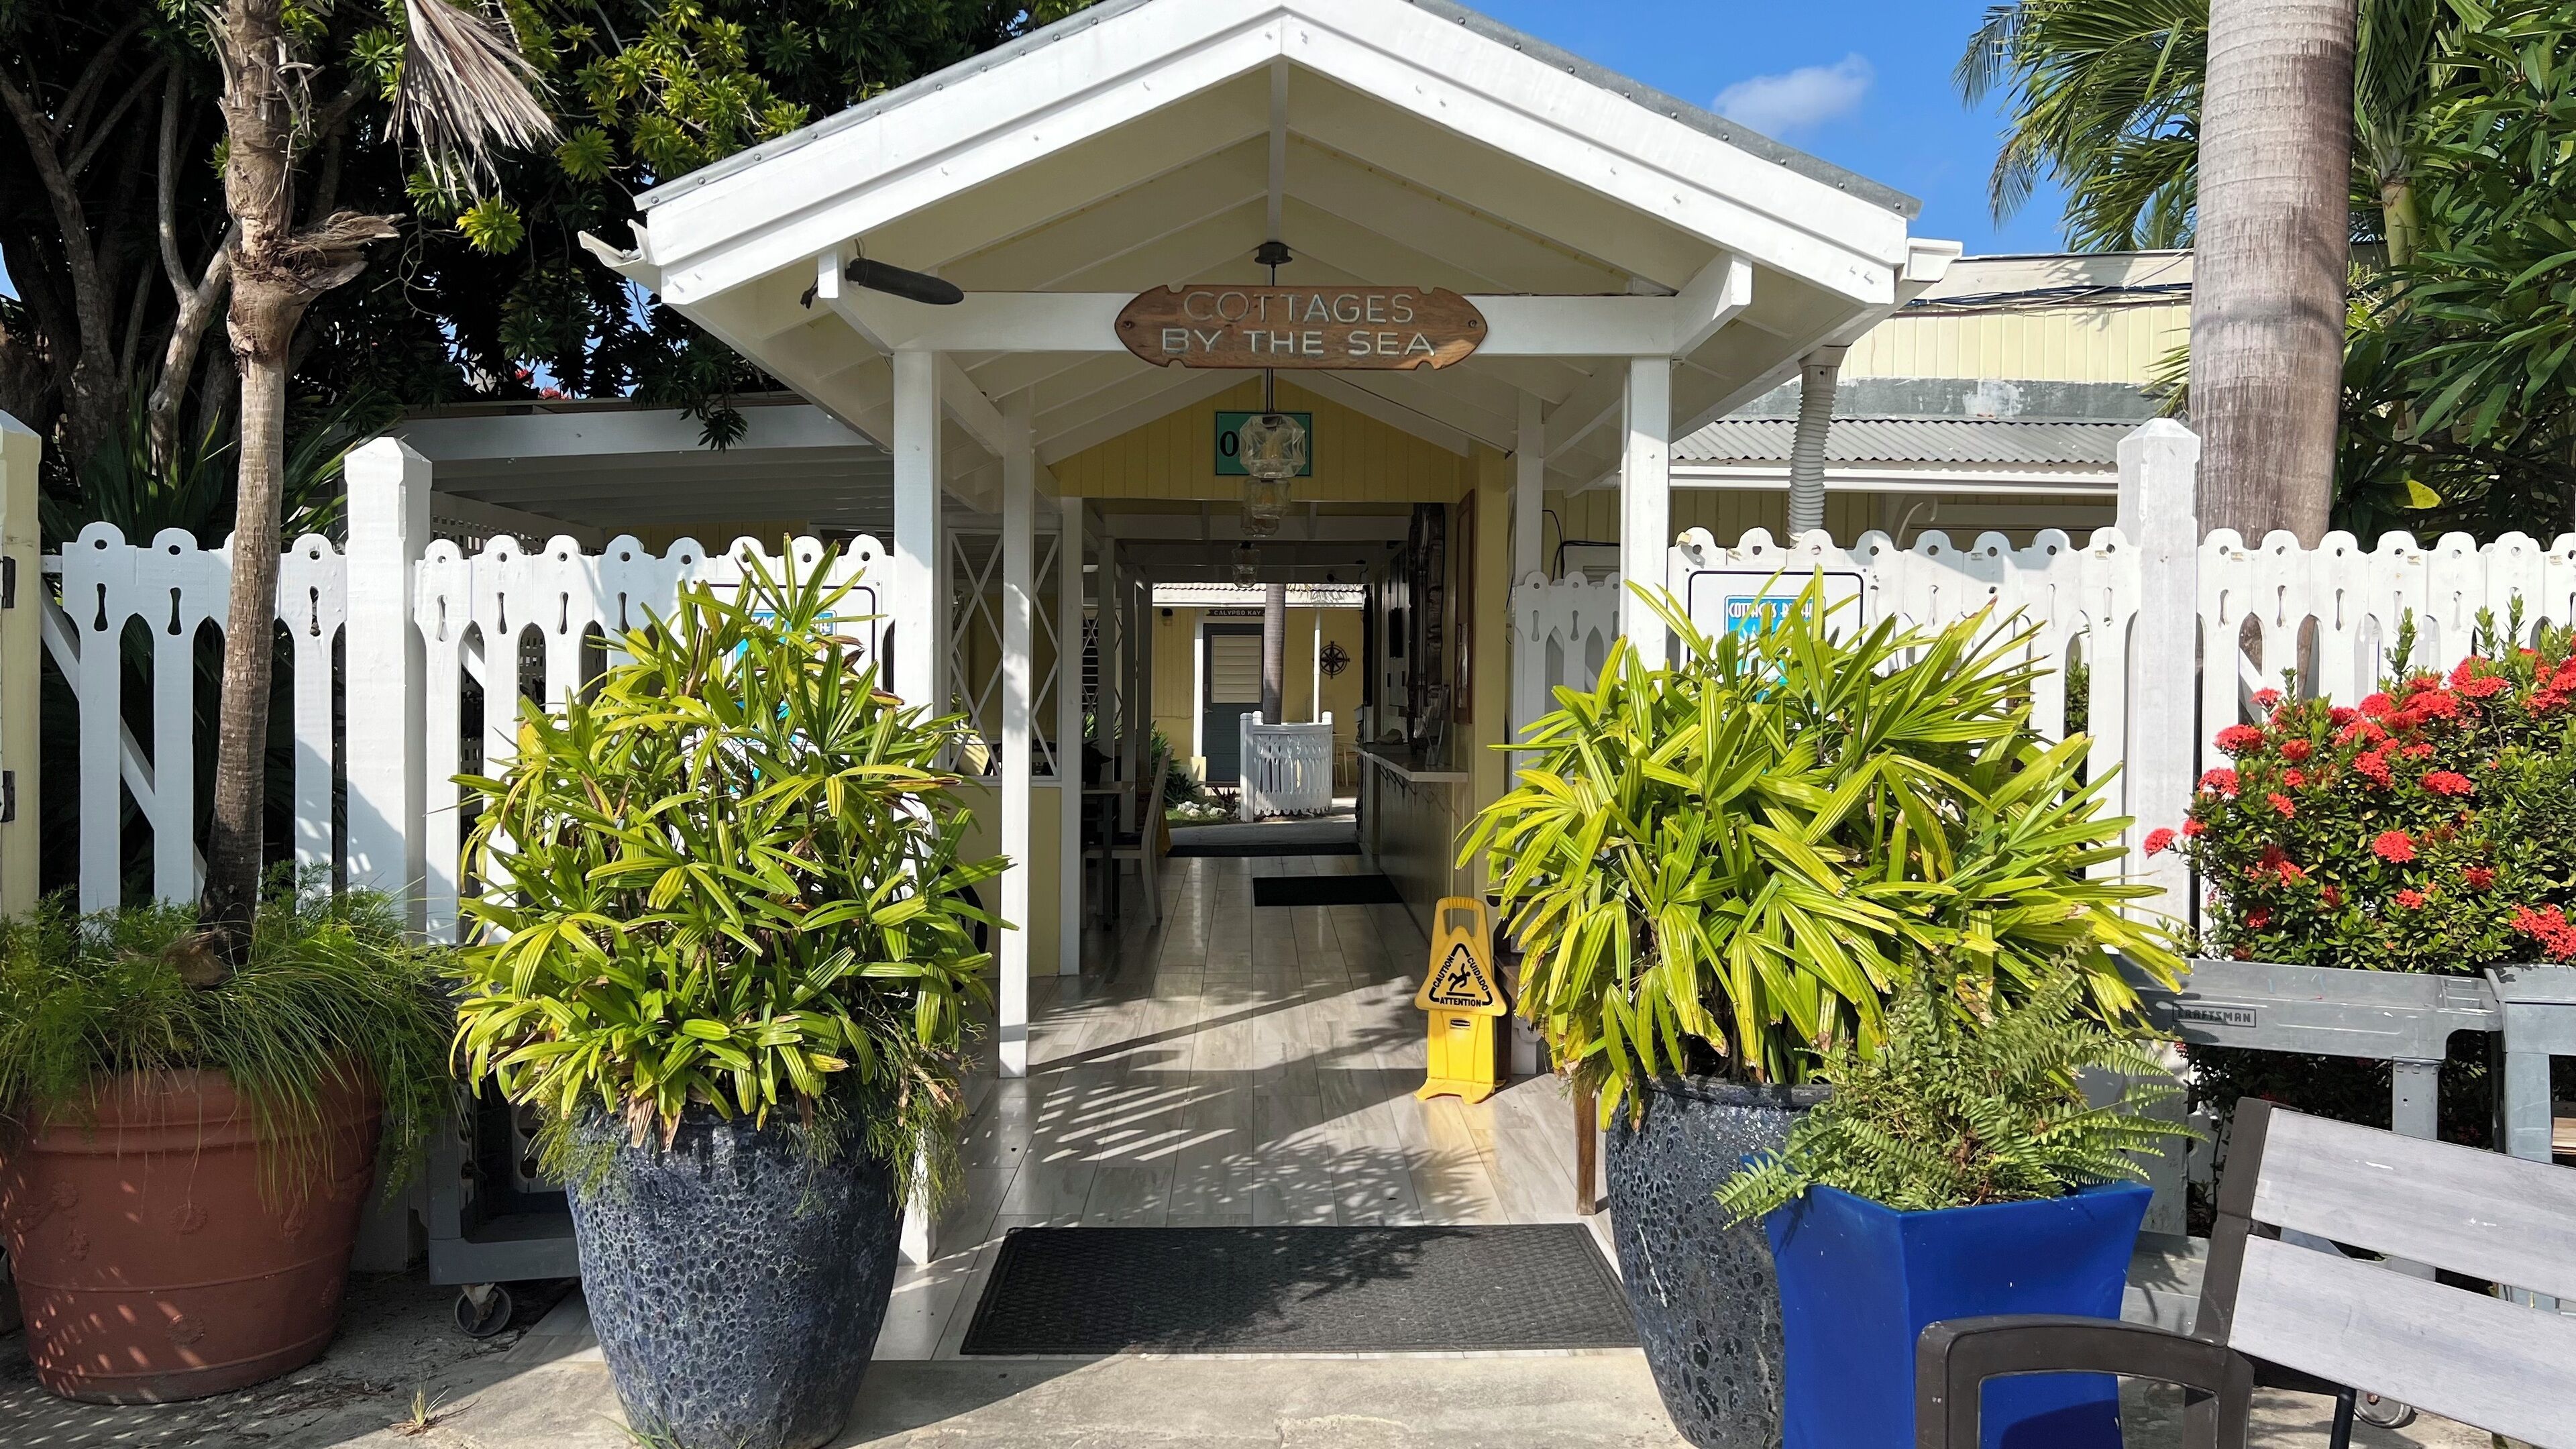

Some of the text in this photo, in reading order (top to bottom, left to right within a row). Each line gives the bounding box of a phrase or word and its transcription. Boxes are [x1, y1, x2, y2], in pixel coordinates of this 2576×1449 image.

[1184, 290, 1414, 323] COTTAGES
[1162, 327, 1436, 356] BY THE SEA
[1432, 955, 1454, 988] CAUTION
[1467, 957, 1489, 991] CUIDADO
[1440, 997, 1481, 1007] ATTENTION
[2178, 1008, 2251, 1023] CRAFTSMAN
